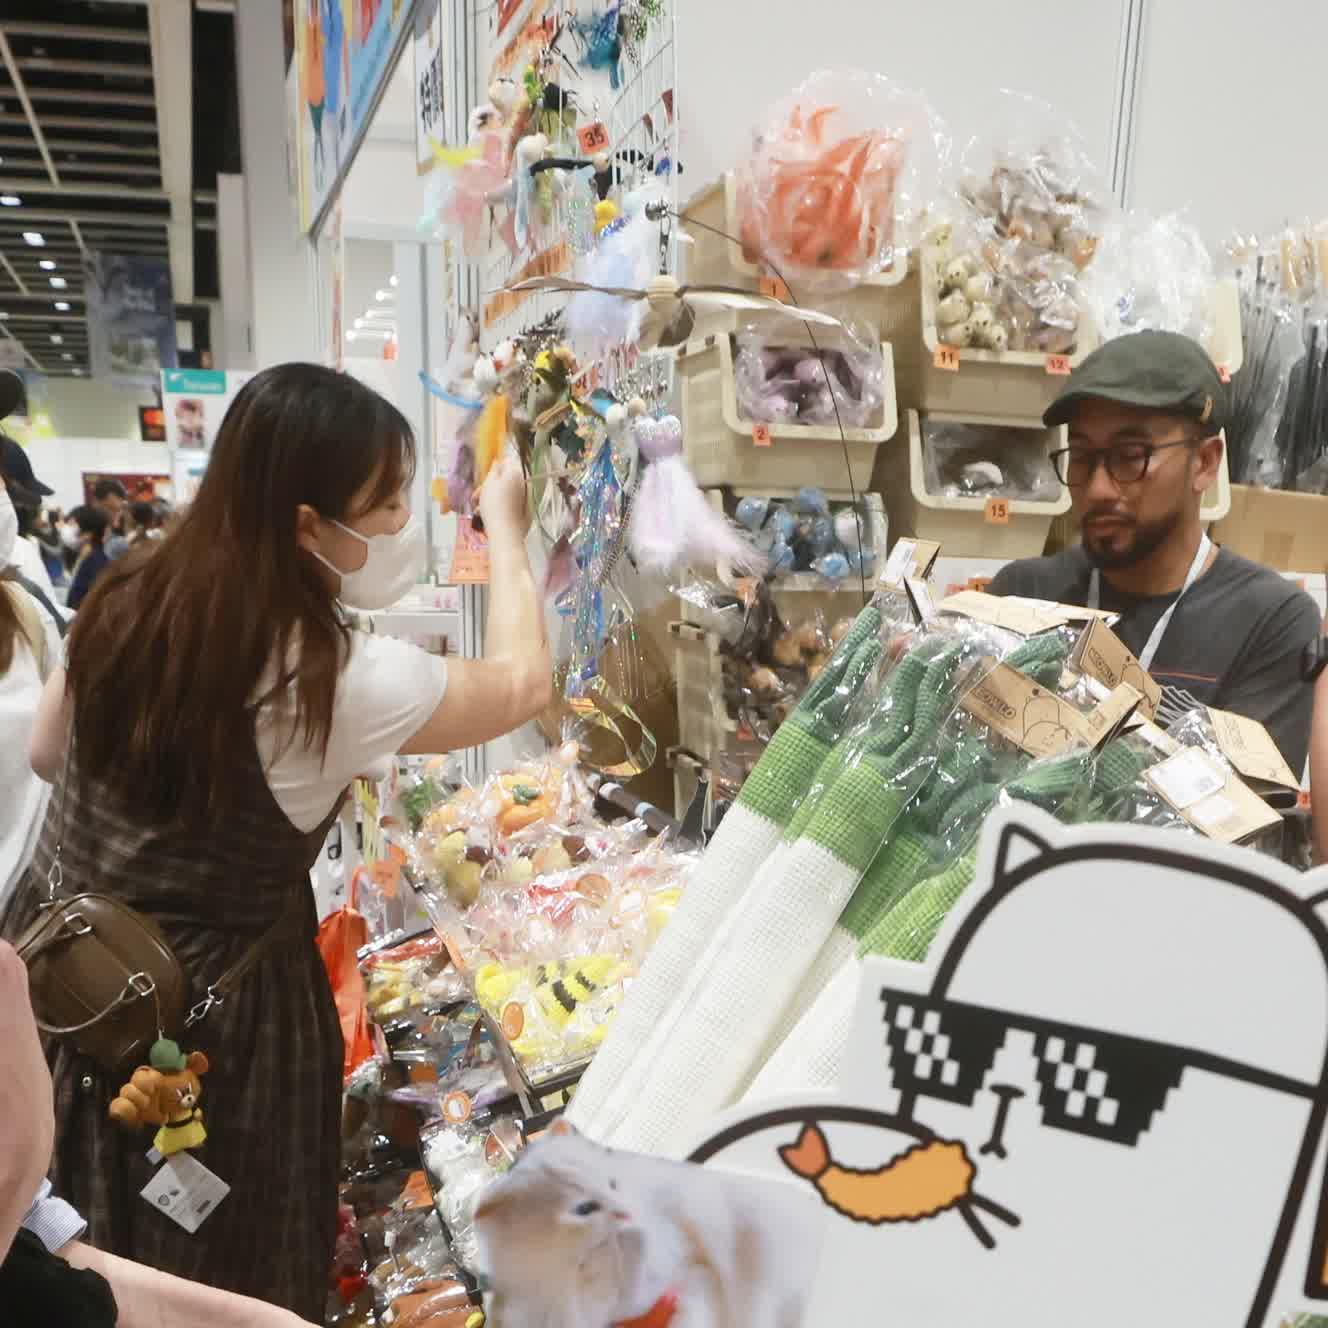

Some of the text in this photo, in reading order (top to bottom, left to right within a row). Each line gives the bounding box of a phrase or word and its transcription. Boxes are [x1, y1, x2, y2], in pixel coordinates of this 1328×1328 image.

[582, 125, 606, 149] 35
[939, 352, 955, 364] 11
[756, 428, 767, 441] 2
[990, 503, 1007, 518] 15
